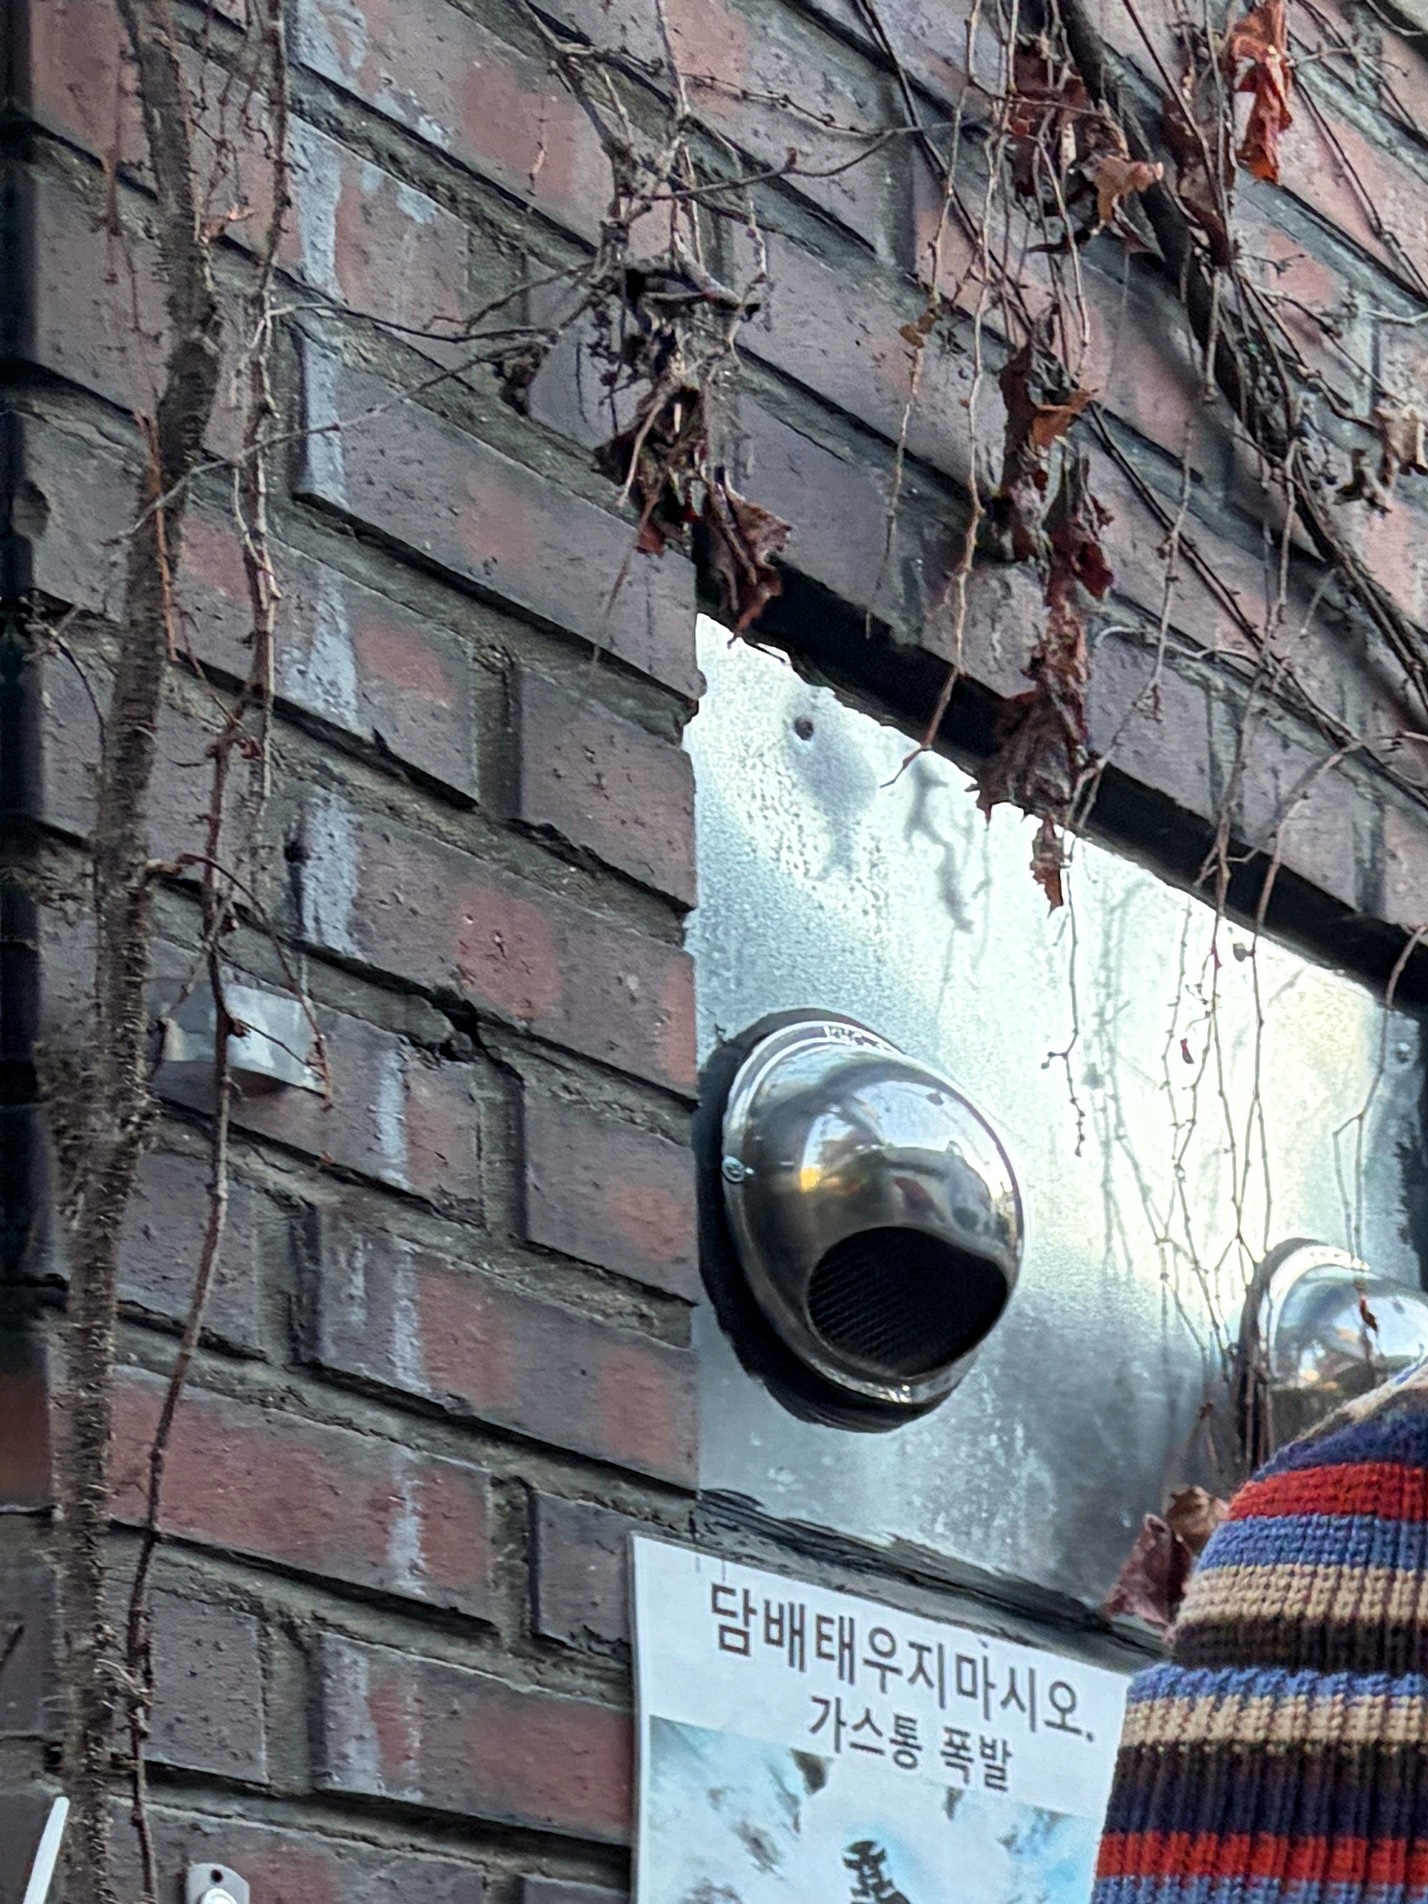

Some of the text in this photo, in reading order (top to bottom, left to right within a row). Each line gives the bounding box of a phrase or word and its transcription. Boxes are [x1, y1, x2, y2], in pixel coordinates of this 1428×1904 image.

[710, 1582, 1095, 1742] 담배태우지마시오.
[809, 1694, 1014, 1793] 가스통 폭발
